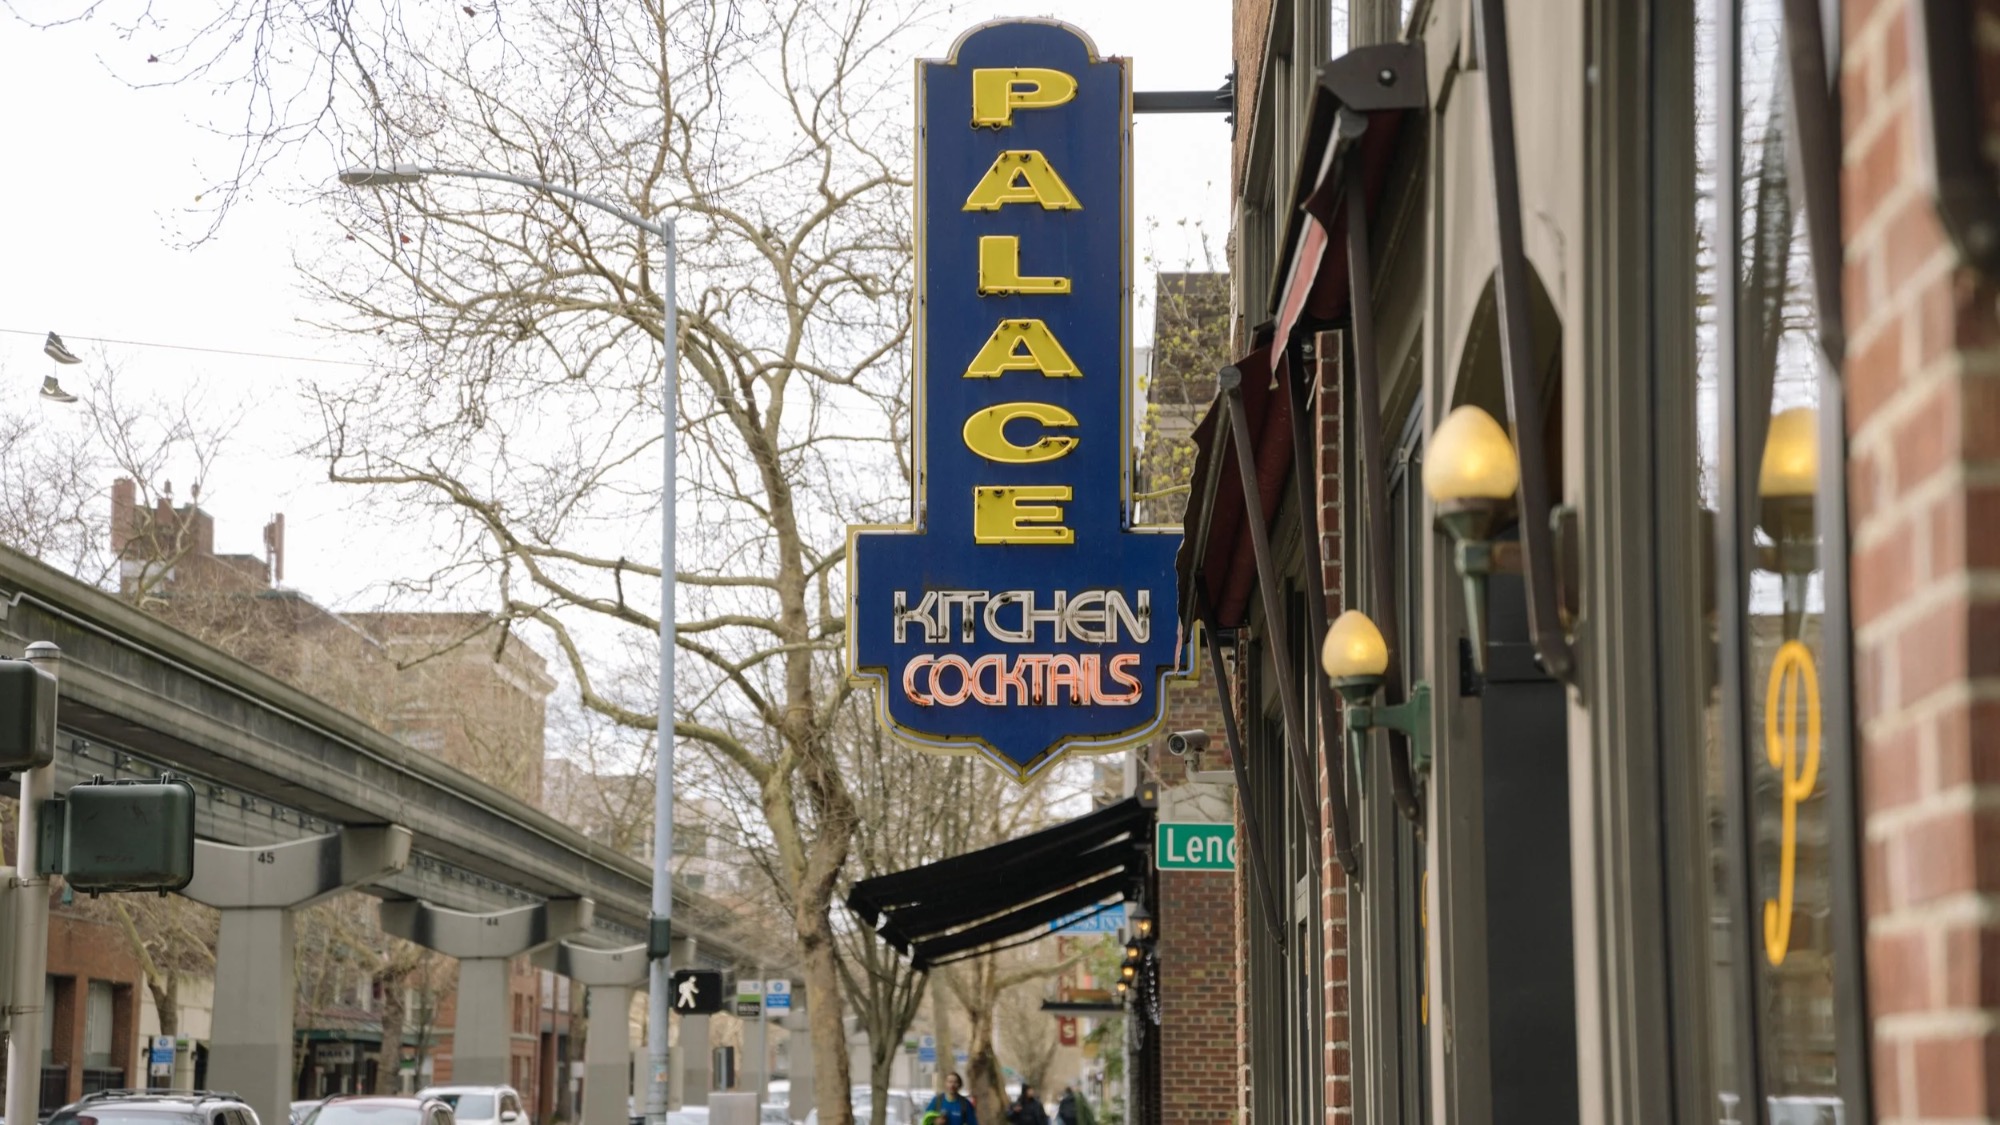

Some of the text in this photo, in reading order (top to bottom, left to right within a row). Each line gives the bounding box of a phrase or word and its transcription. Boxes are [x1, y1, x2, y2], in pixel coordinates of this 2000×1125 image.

[962, 67, 1083, 545] PALACE
[894, 590, 1150, 643] KITCHEN
[903, 654, 1143, 706] COCKTAILS
[257, 851, 275, 864] 45
[486, 917, 499, 927] 44
